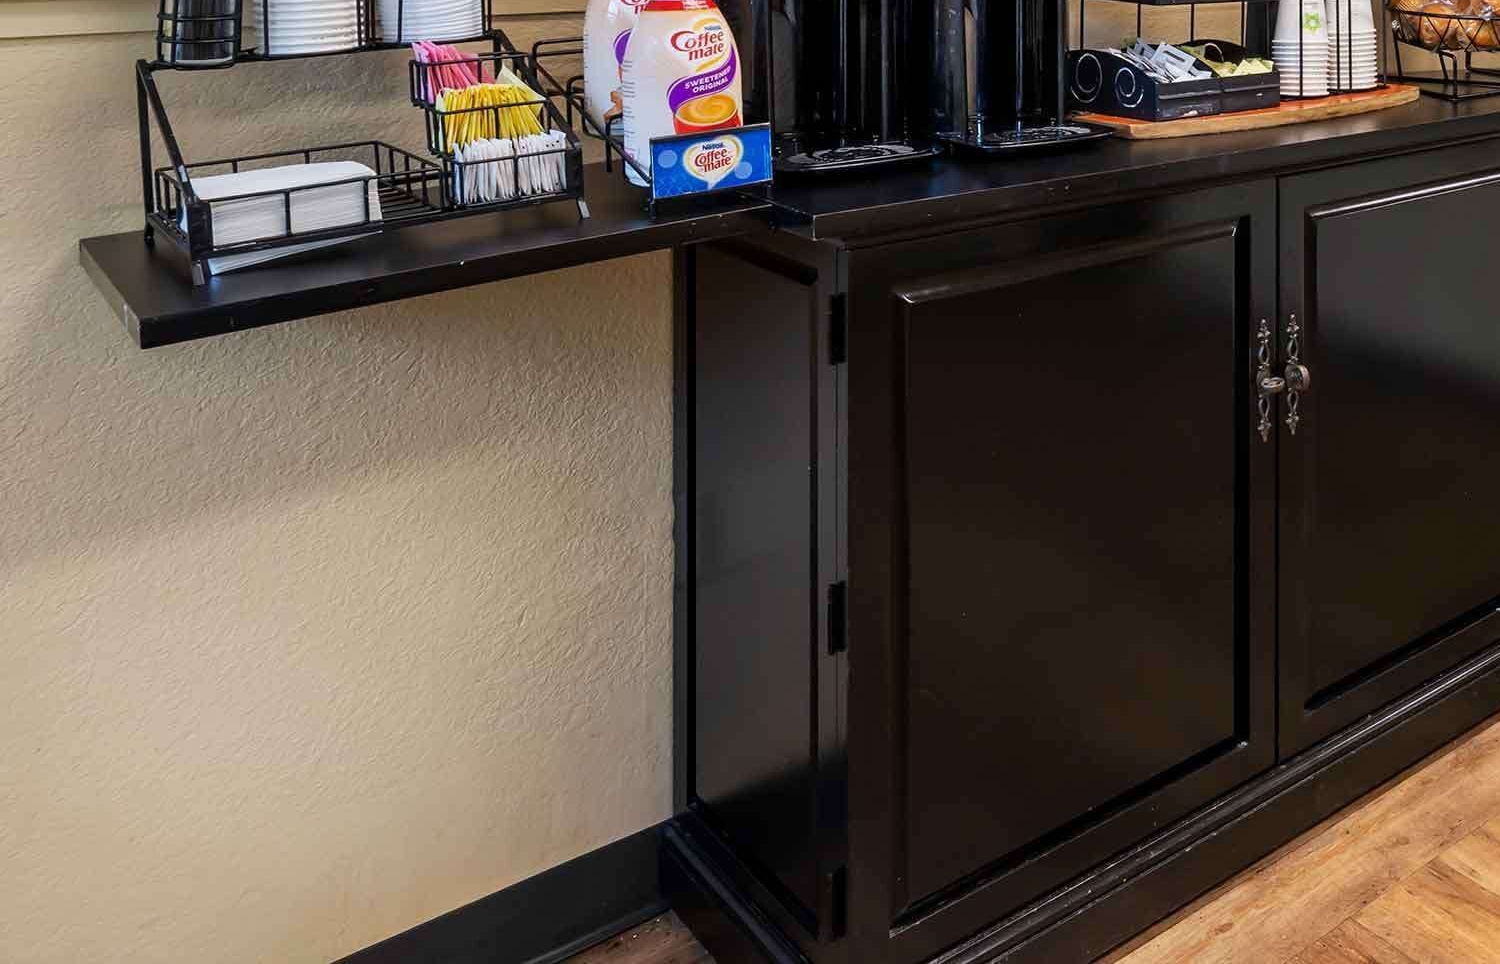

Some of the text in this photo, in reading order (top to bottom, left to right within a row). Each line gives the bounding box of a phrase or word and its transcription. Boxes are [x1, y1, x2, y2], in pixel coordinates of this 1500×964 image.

[670, 29, 724, 52] Coffee
[688, 42, 724, 61] mate
[684, 65, 732, 90] SWEETENED
[692, 77, 729, 93] ORIGINAL
[694, 148, 728, 167] Coffee
[703, 157, 732, 173] mate
